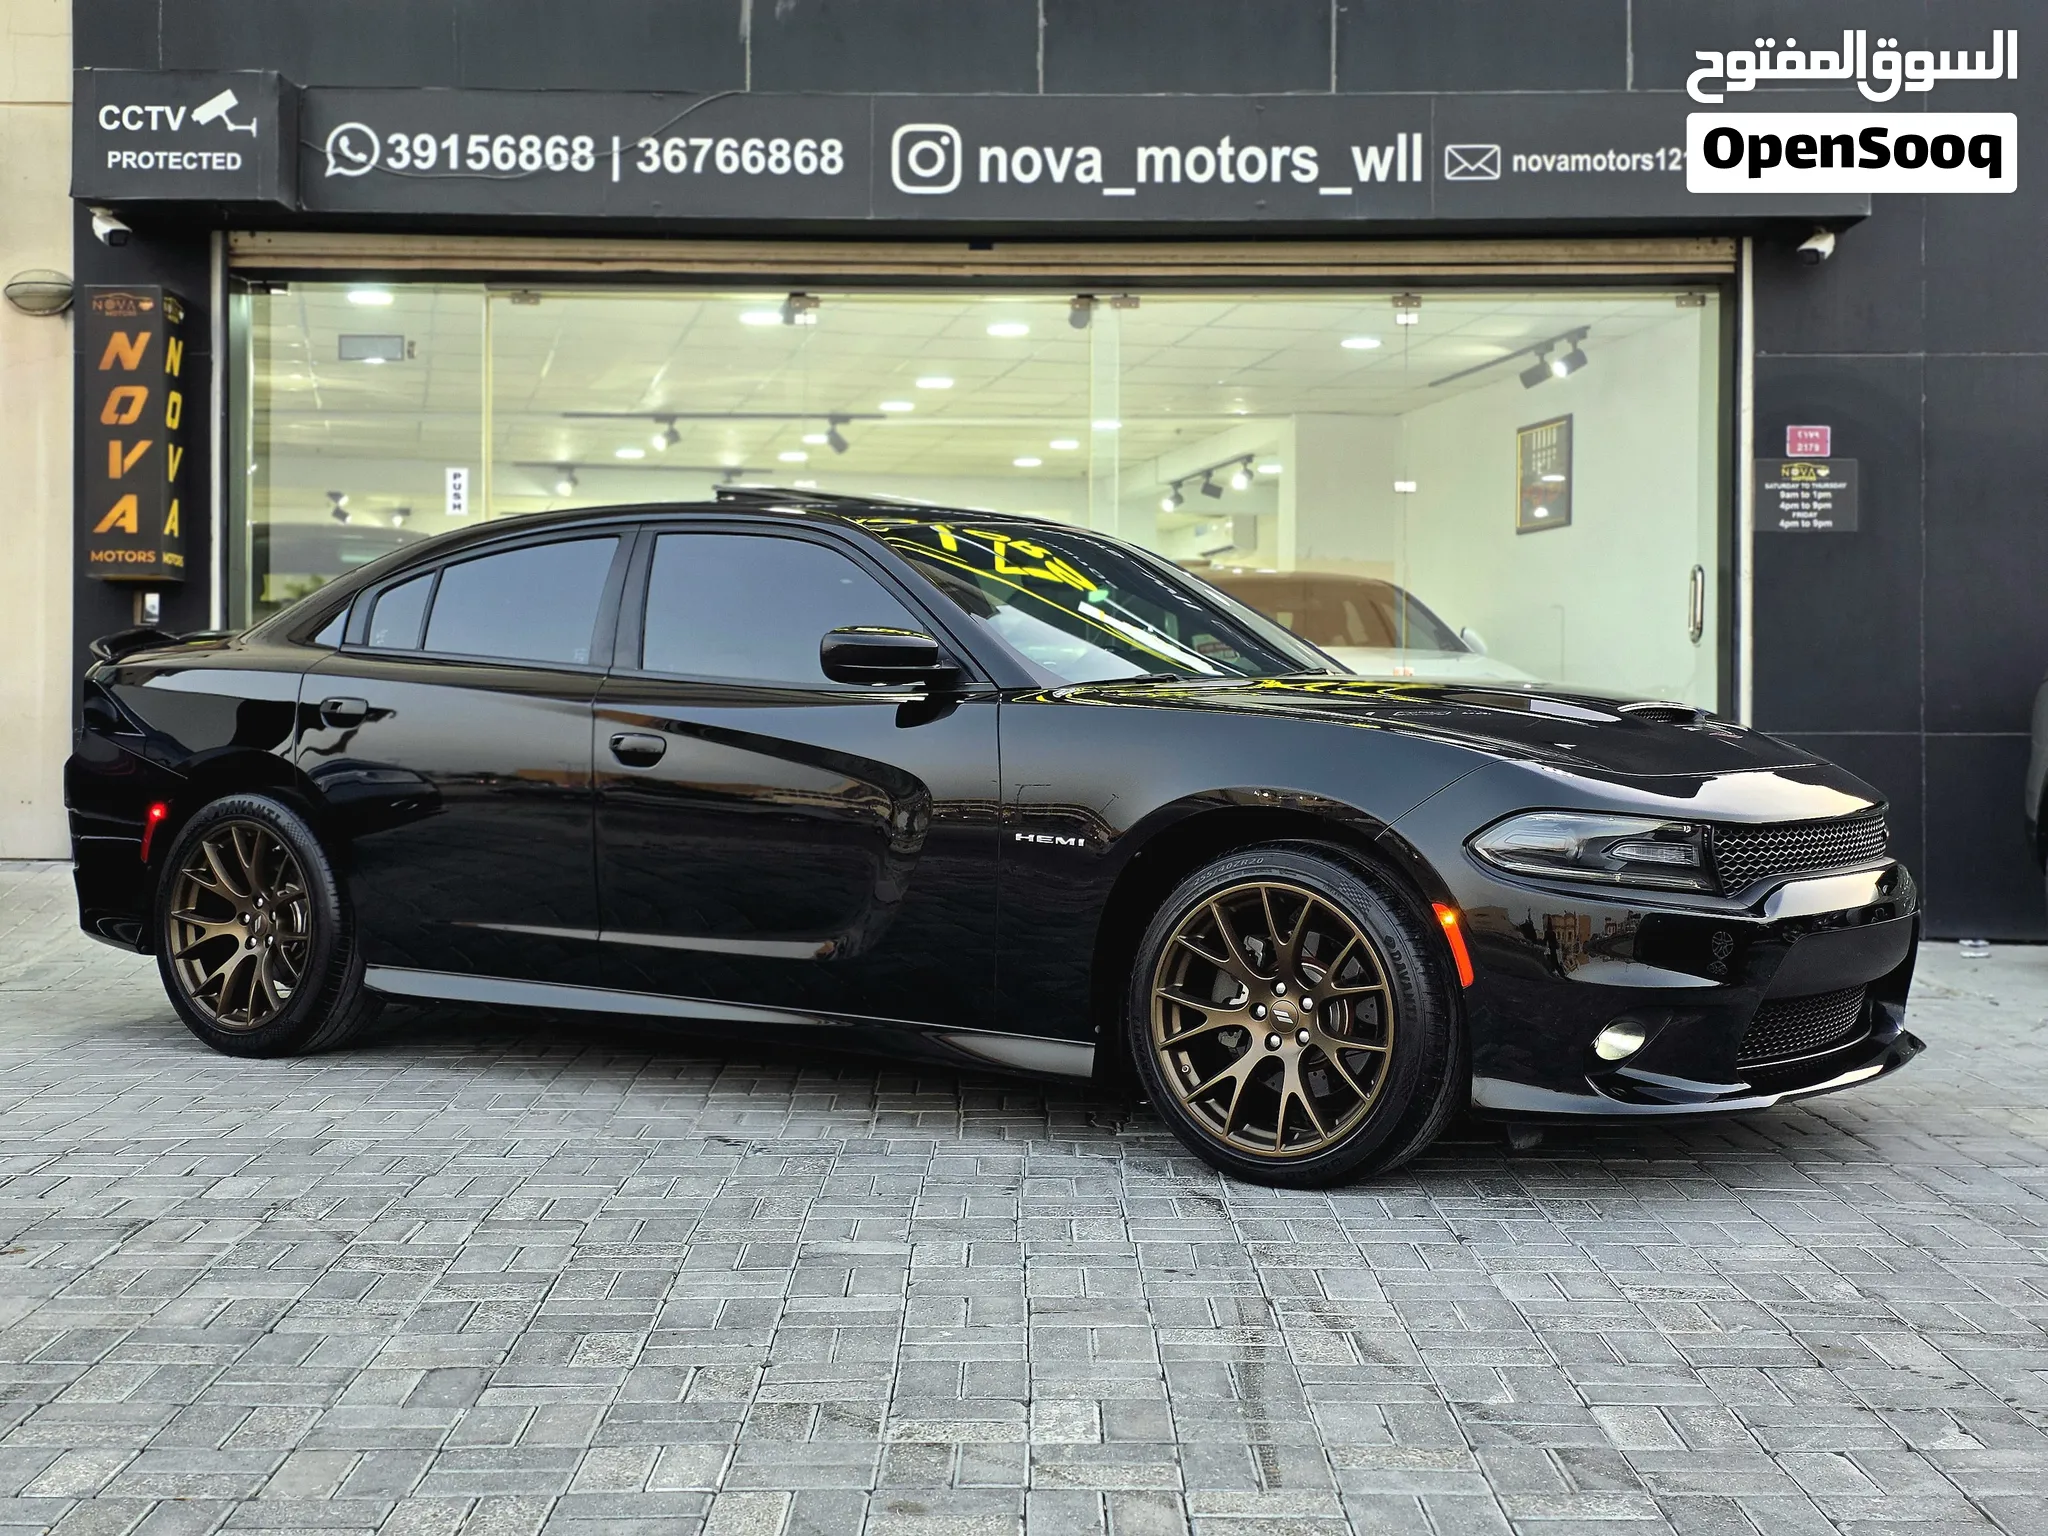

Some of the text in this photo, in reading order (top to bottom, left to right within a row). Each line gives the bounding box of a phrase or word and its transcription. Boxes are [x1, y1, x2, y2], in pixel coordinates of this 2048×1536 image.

[98, 104, 187, 132] CCTV
[107, 150, 242, 171] PROTECTED
[386, 133, 596, 172] 39156868
[636, 137, 844, 175] 36766868
[978, 132, 1423, 196] nova_motors_wll
[1512, 147, 1686, 173] novamotors12
[452, 472, 462, 511] PUSH
[90, 549, 157, 563] MOTORS
[1015, 833, 1085, 847] HEMI
